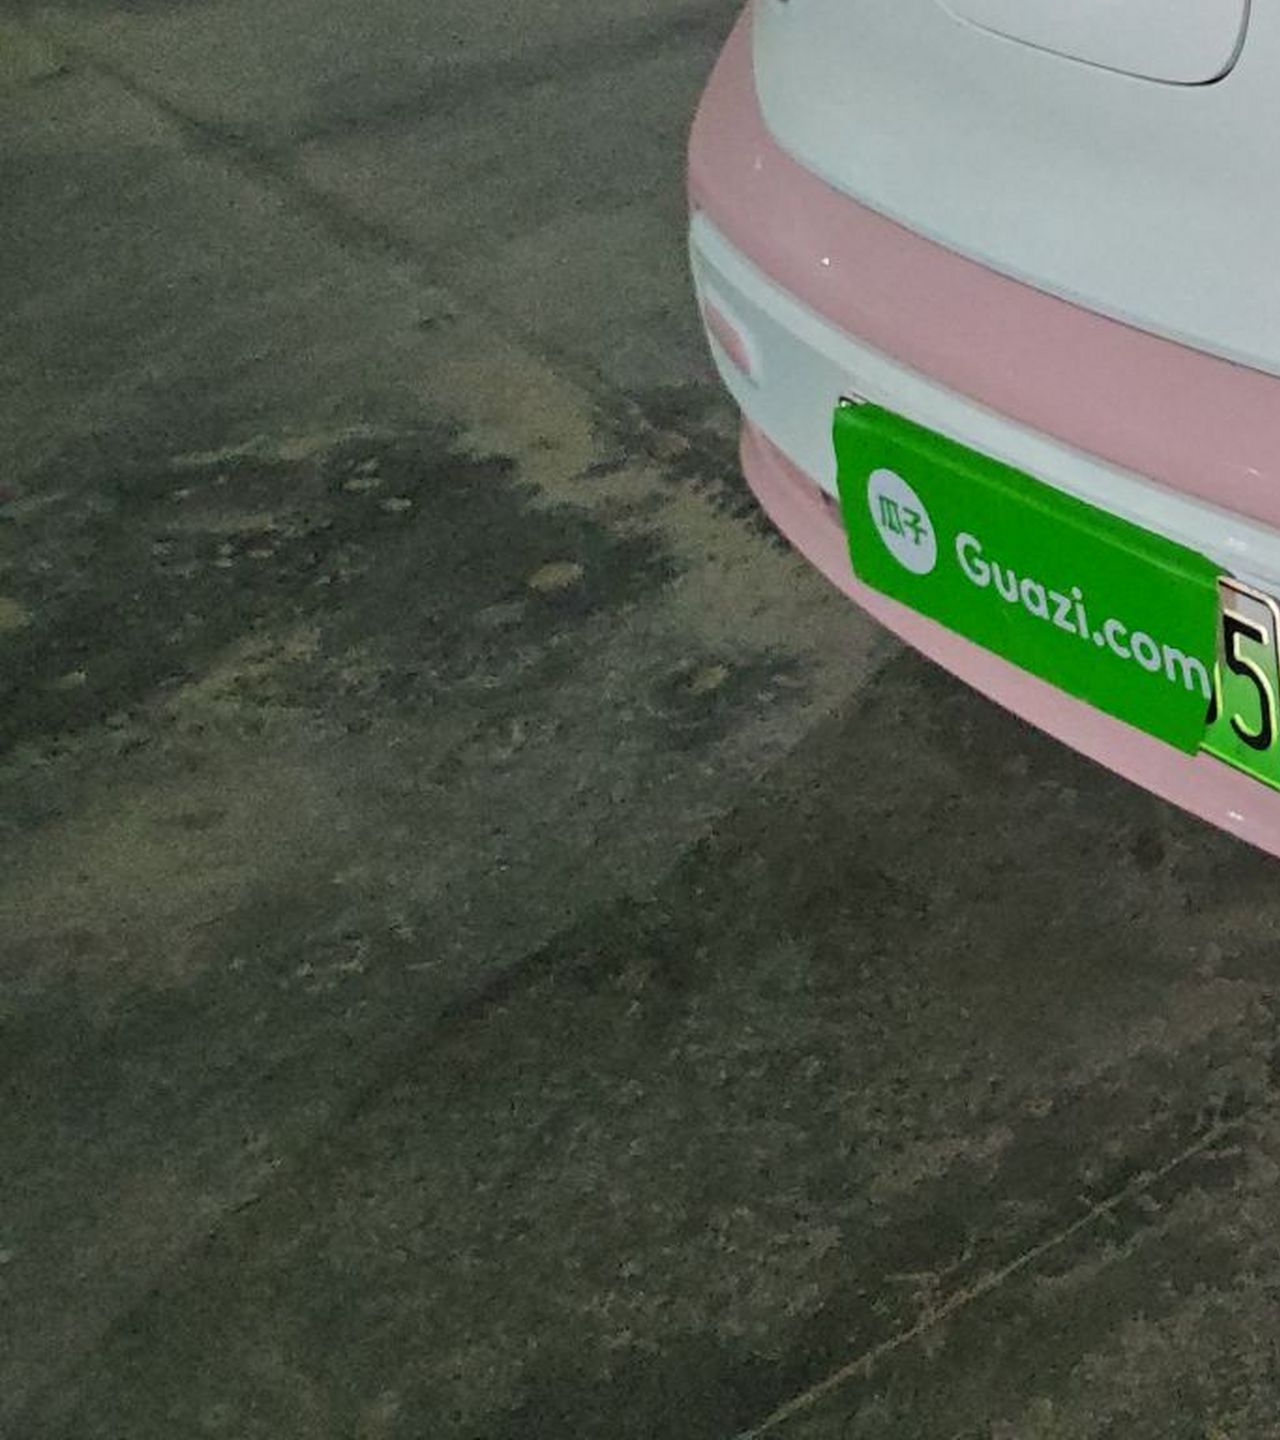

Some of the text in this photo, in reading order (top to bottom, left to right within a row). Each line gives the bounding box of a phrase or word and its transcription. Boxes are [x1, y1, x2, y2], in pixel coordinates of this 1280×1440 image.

[878, 495, 928, 546] 瓜子
[955, 532, 1212, 700] Guazi.com
[1207, 610, 1278, 751] 5
